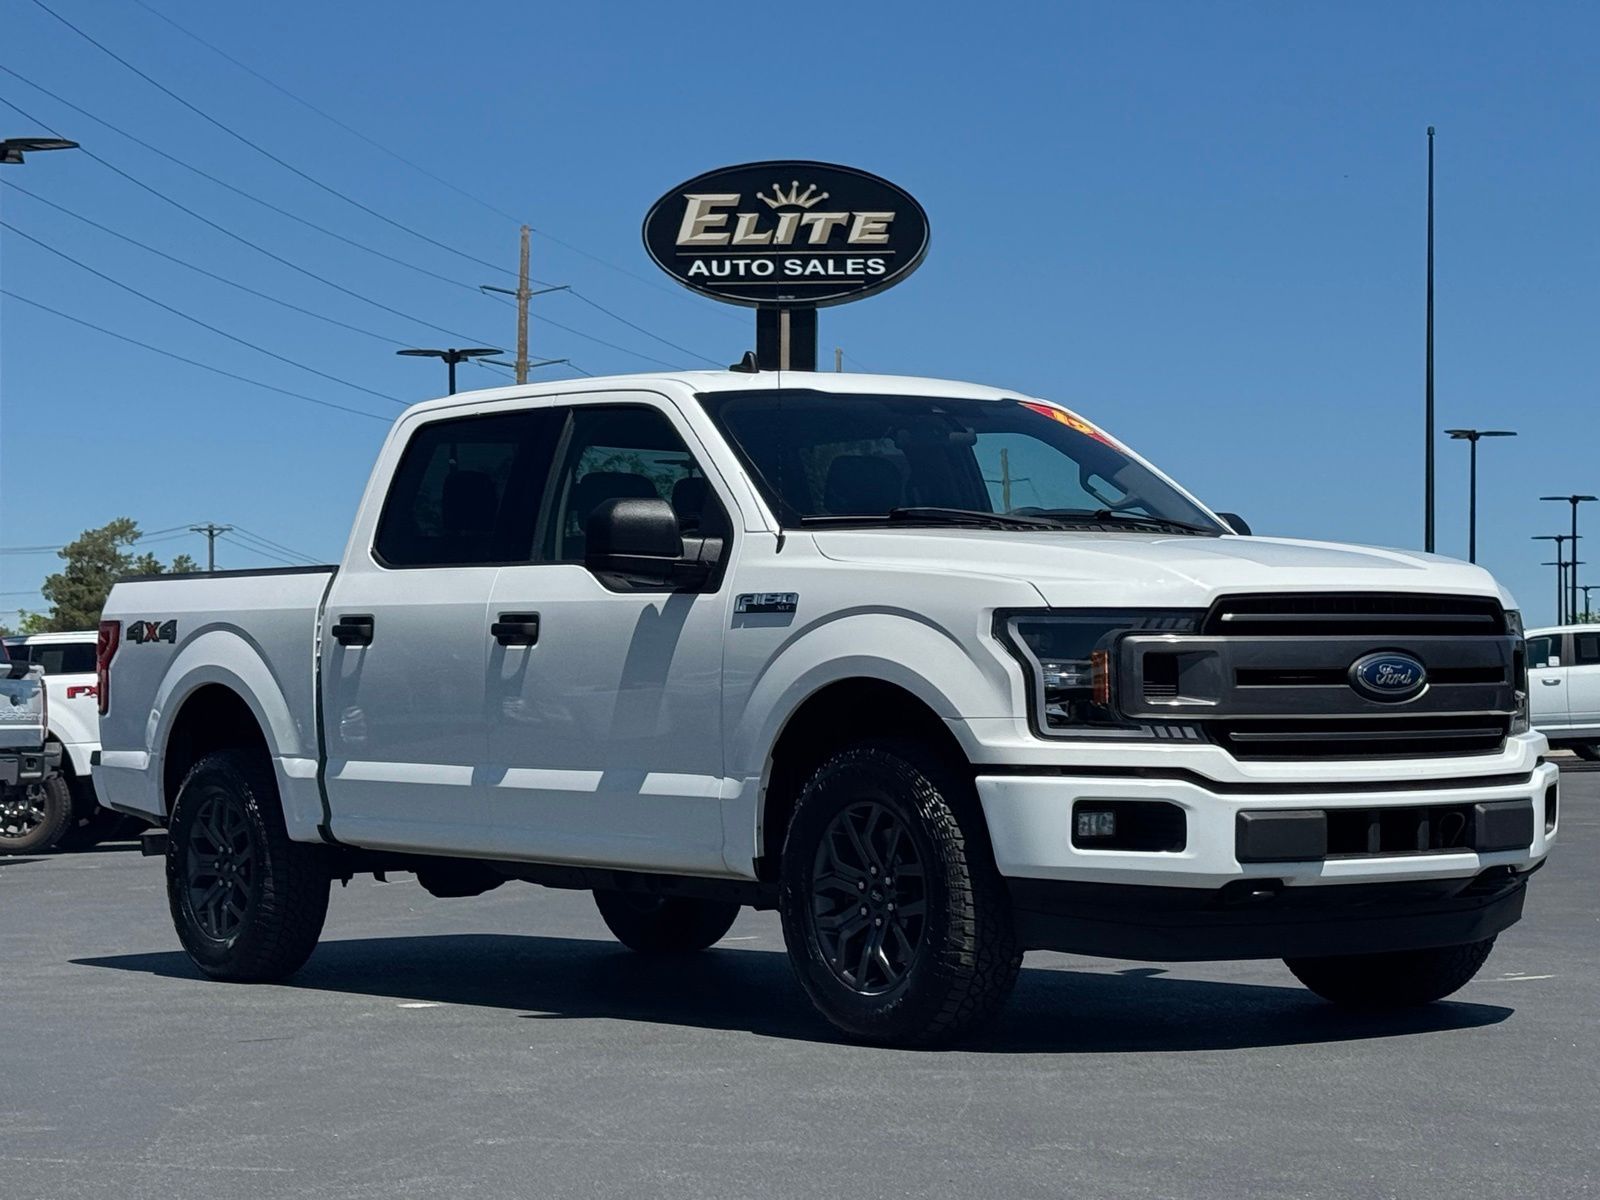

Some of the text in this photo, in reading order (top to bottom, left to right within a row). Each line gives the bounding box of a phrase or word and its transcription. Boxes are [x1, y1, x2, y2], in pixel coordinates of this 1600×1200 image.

[675, 193, 896, 246] ELITE
[687, 258, 886, 277] AUTO SALES
[1376, 663, 1412, 684] Ford
